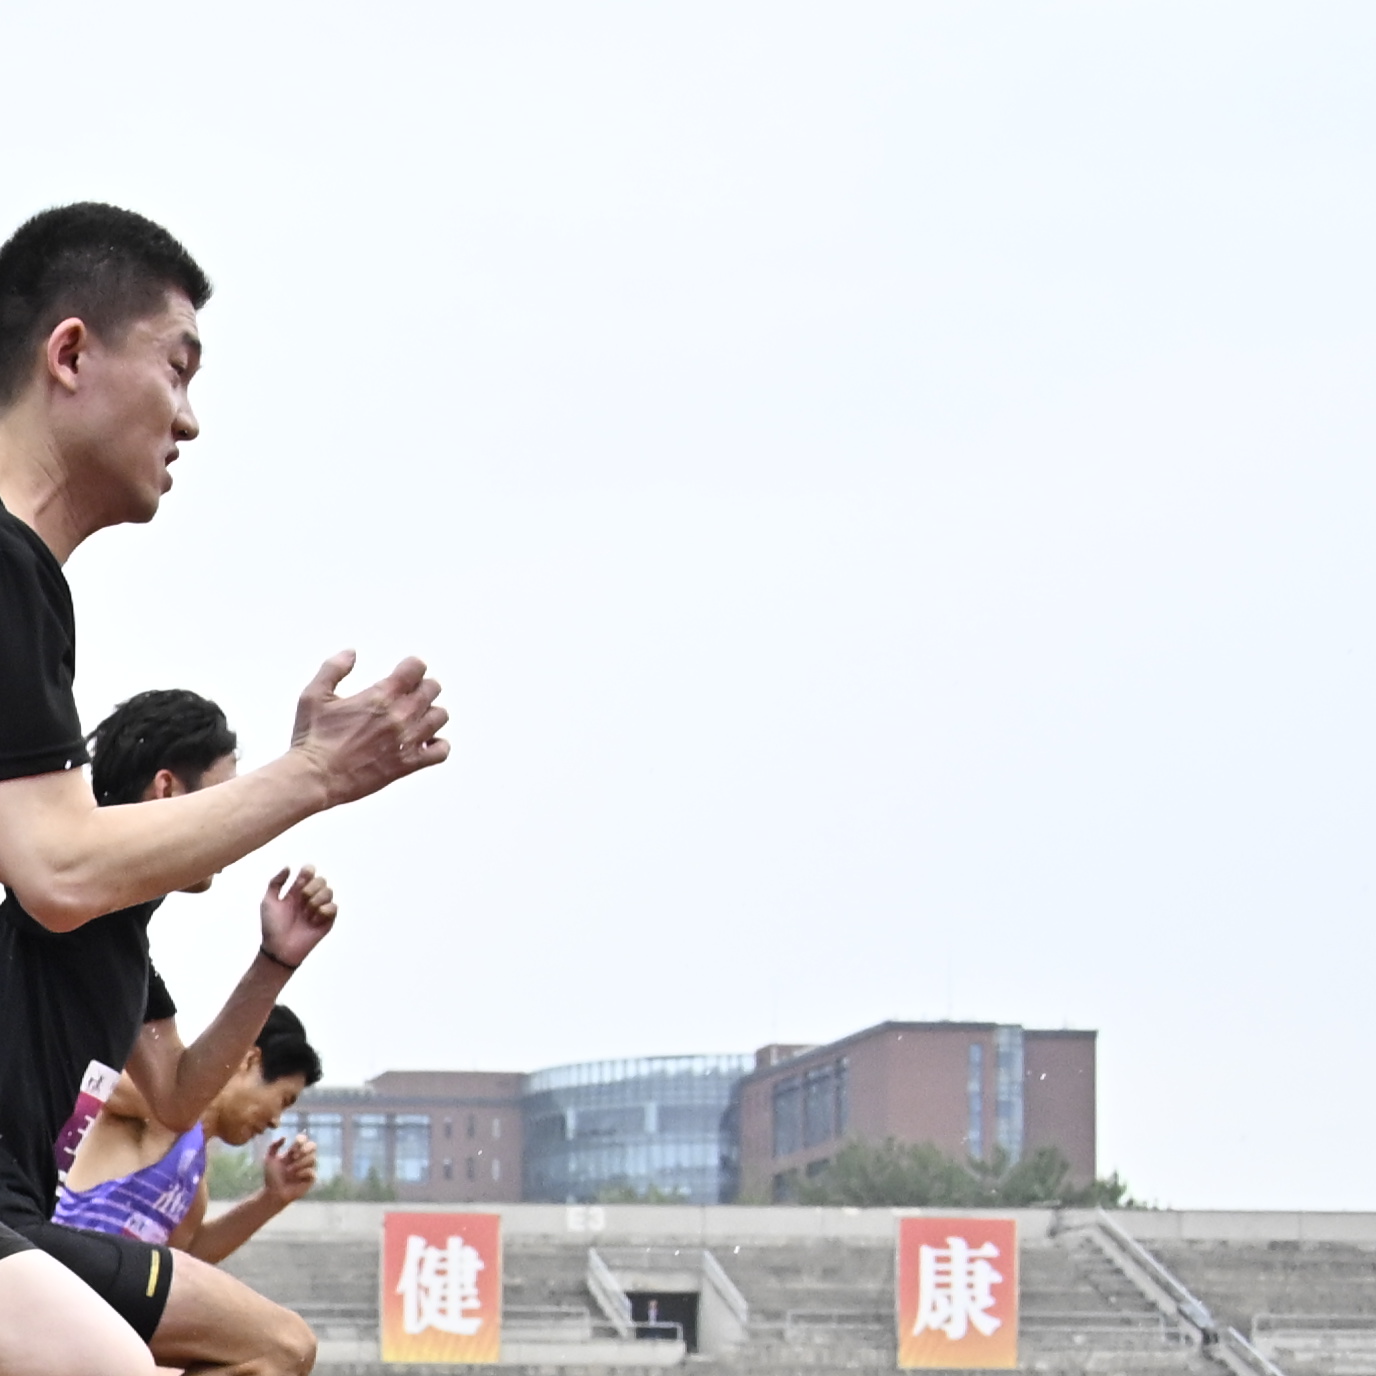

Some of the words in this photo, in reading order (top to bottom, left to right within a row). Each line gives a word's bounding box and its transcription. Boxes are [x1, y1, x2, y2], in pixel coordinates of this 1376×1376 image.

[566, 1206, 605, 1232] E3
[396, 1234, 485, 1335] 健
[913, 1236, 1003, 1340] 康
